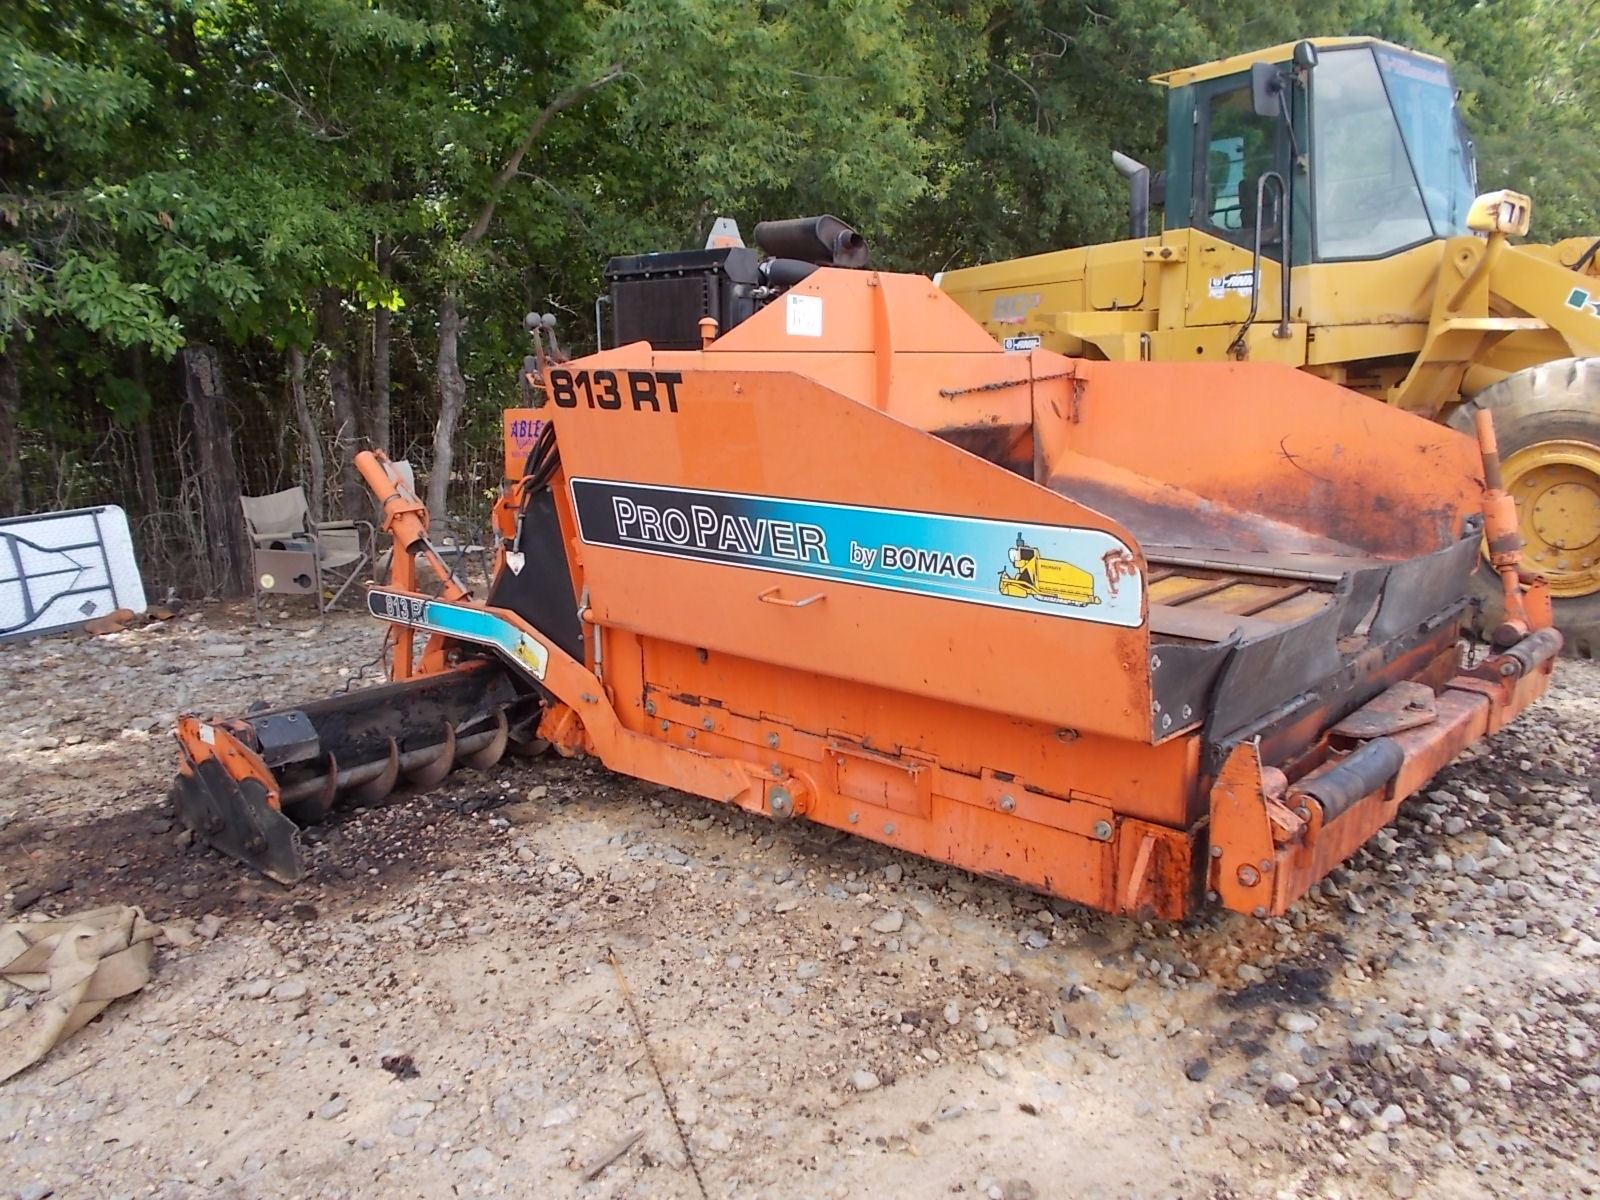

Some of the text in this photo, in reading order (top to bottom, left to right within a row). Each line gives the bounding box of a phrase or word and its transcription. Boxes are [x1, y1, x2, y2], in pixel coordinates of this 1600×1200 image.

[550, 369, 683, 413] 813 RT
[511, 420, 541, 438] ABLE
[850, 541, 877, 570] by
[881, 545, 976, 580] BOMAG
[385, 595, 409, 620] 813
